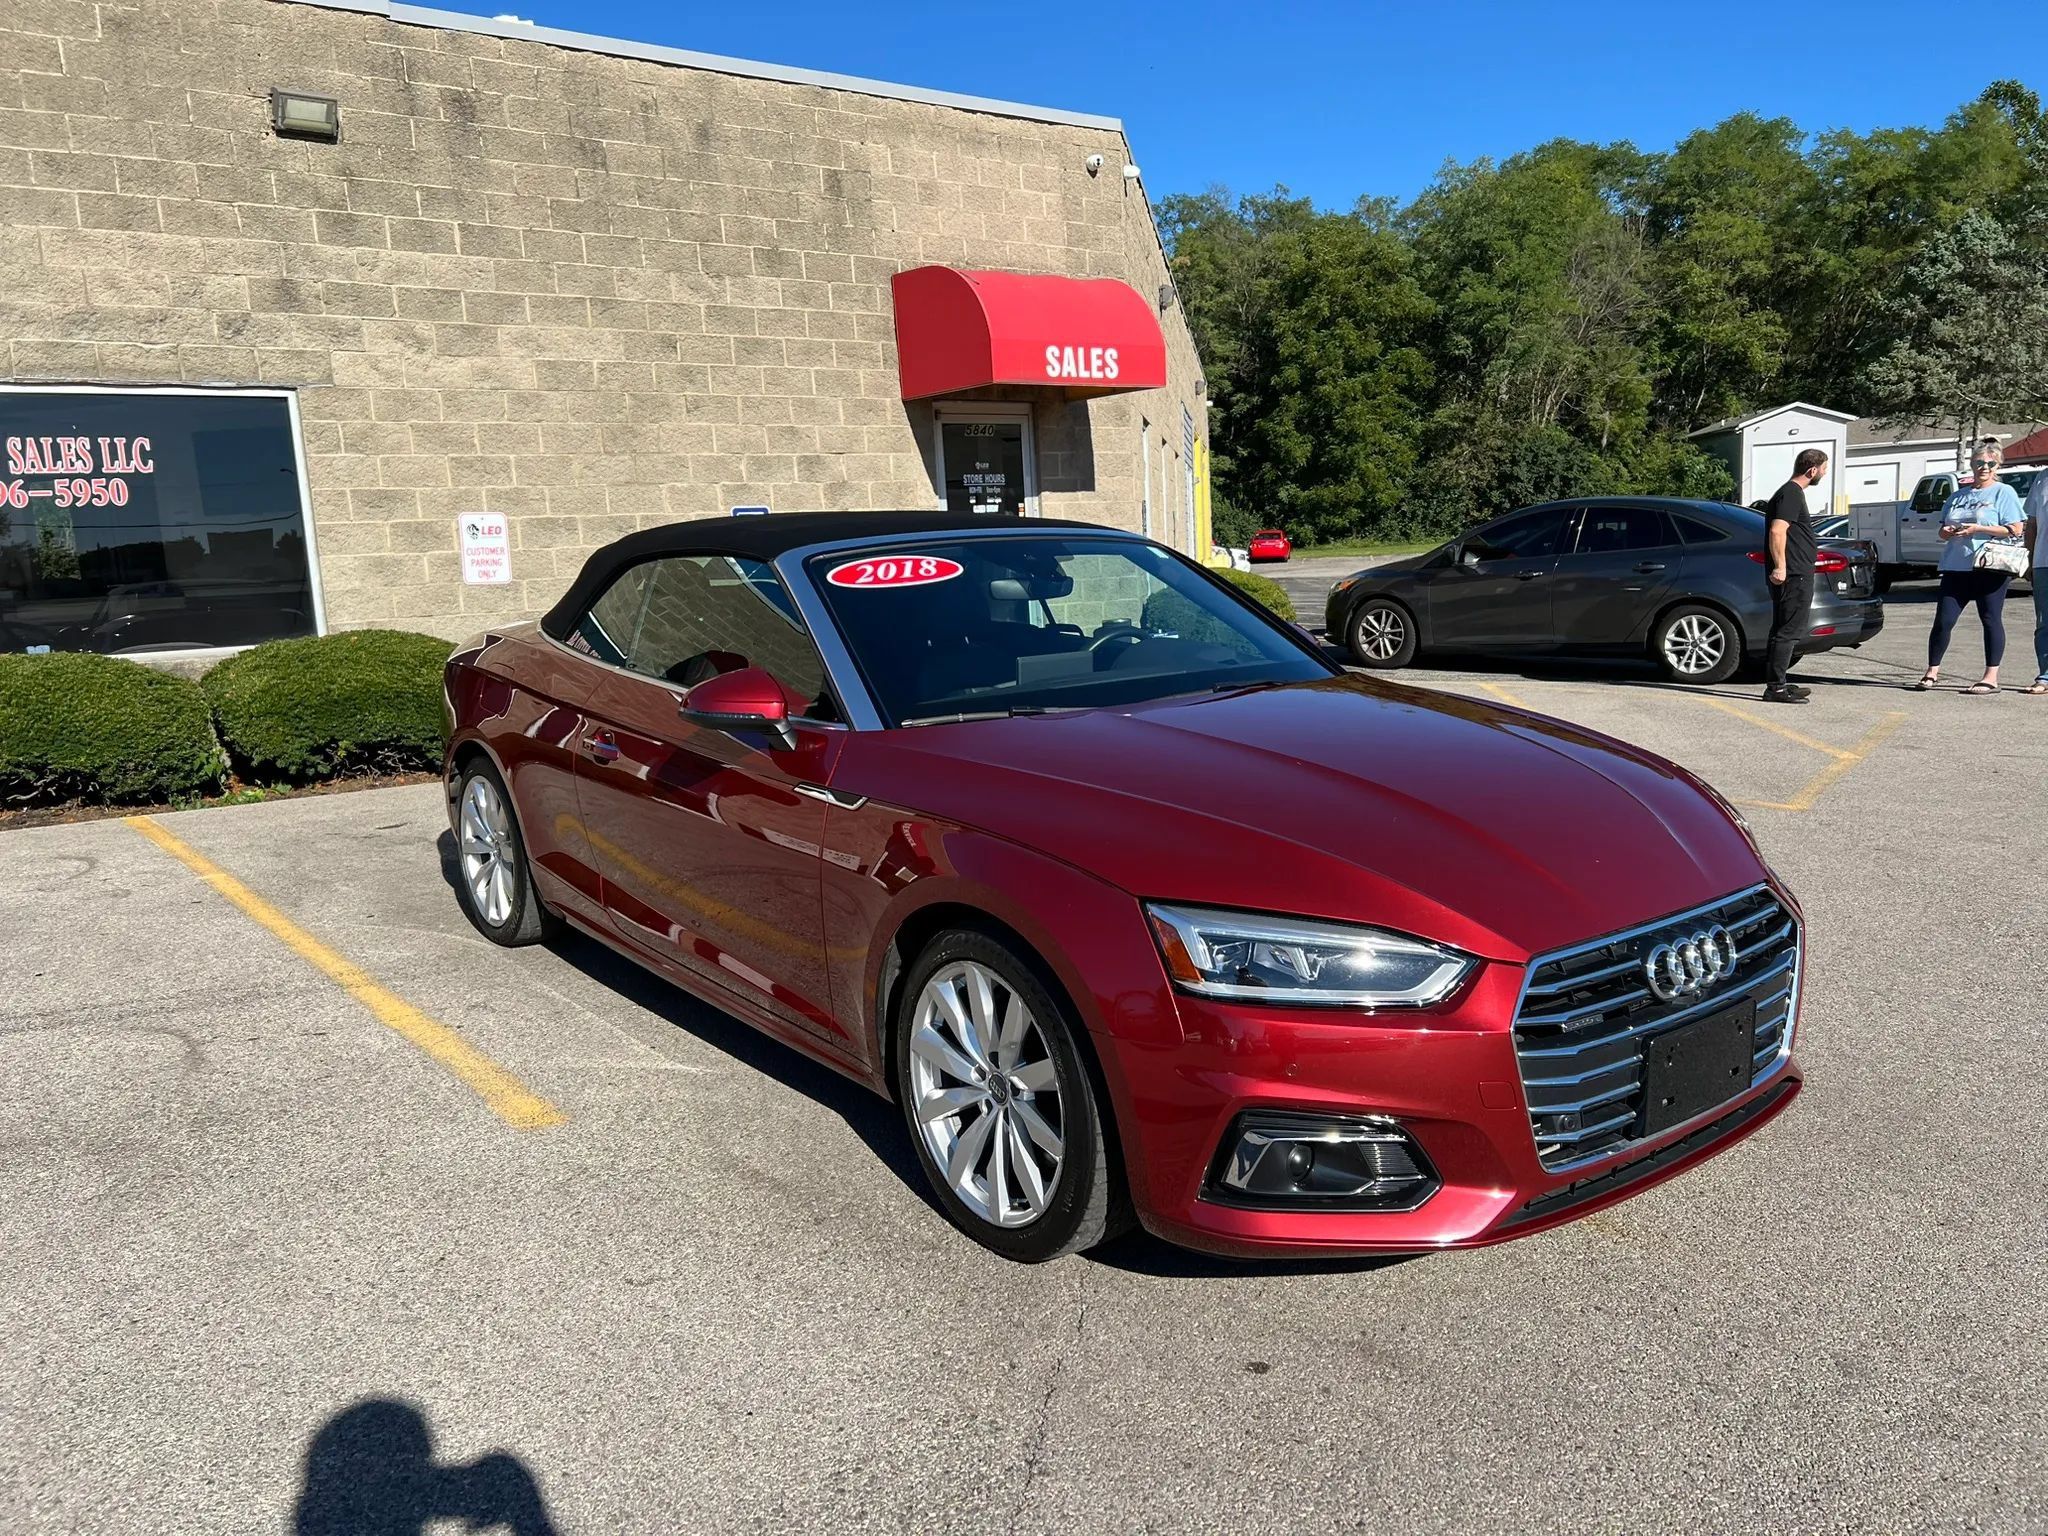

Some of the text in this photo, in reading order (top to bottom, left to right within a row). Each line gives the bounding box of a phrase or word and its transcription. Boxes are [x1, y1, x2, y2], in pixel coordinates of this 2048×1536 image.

[1045, 345, 1119, 379] SALES
[966, 425, 994, 436] 5840
[7, 436, 153, 475] SALES LLC
[963, 473, 1006, 484] STORE HOURS
[481, 526, 502, 535] LEO
[466, 547, 506, 556] CUSTOMER
[471, 558, 503, 567] PARKING
[478, 569, 497, 579] ONLY
[855, 558, 938, 584] 2018
